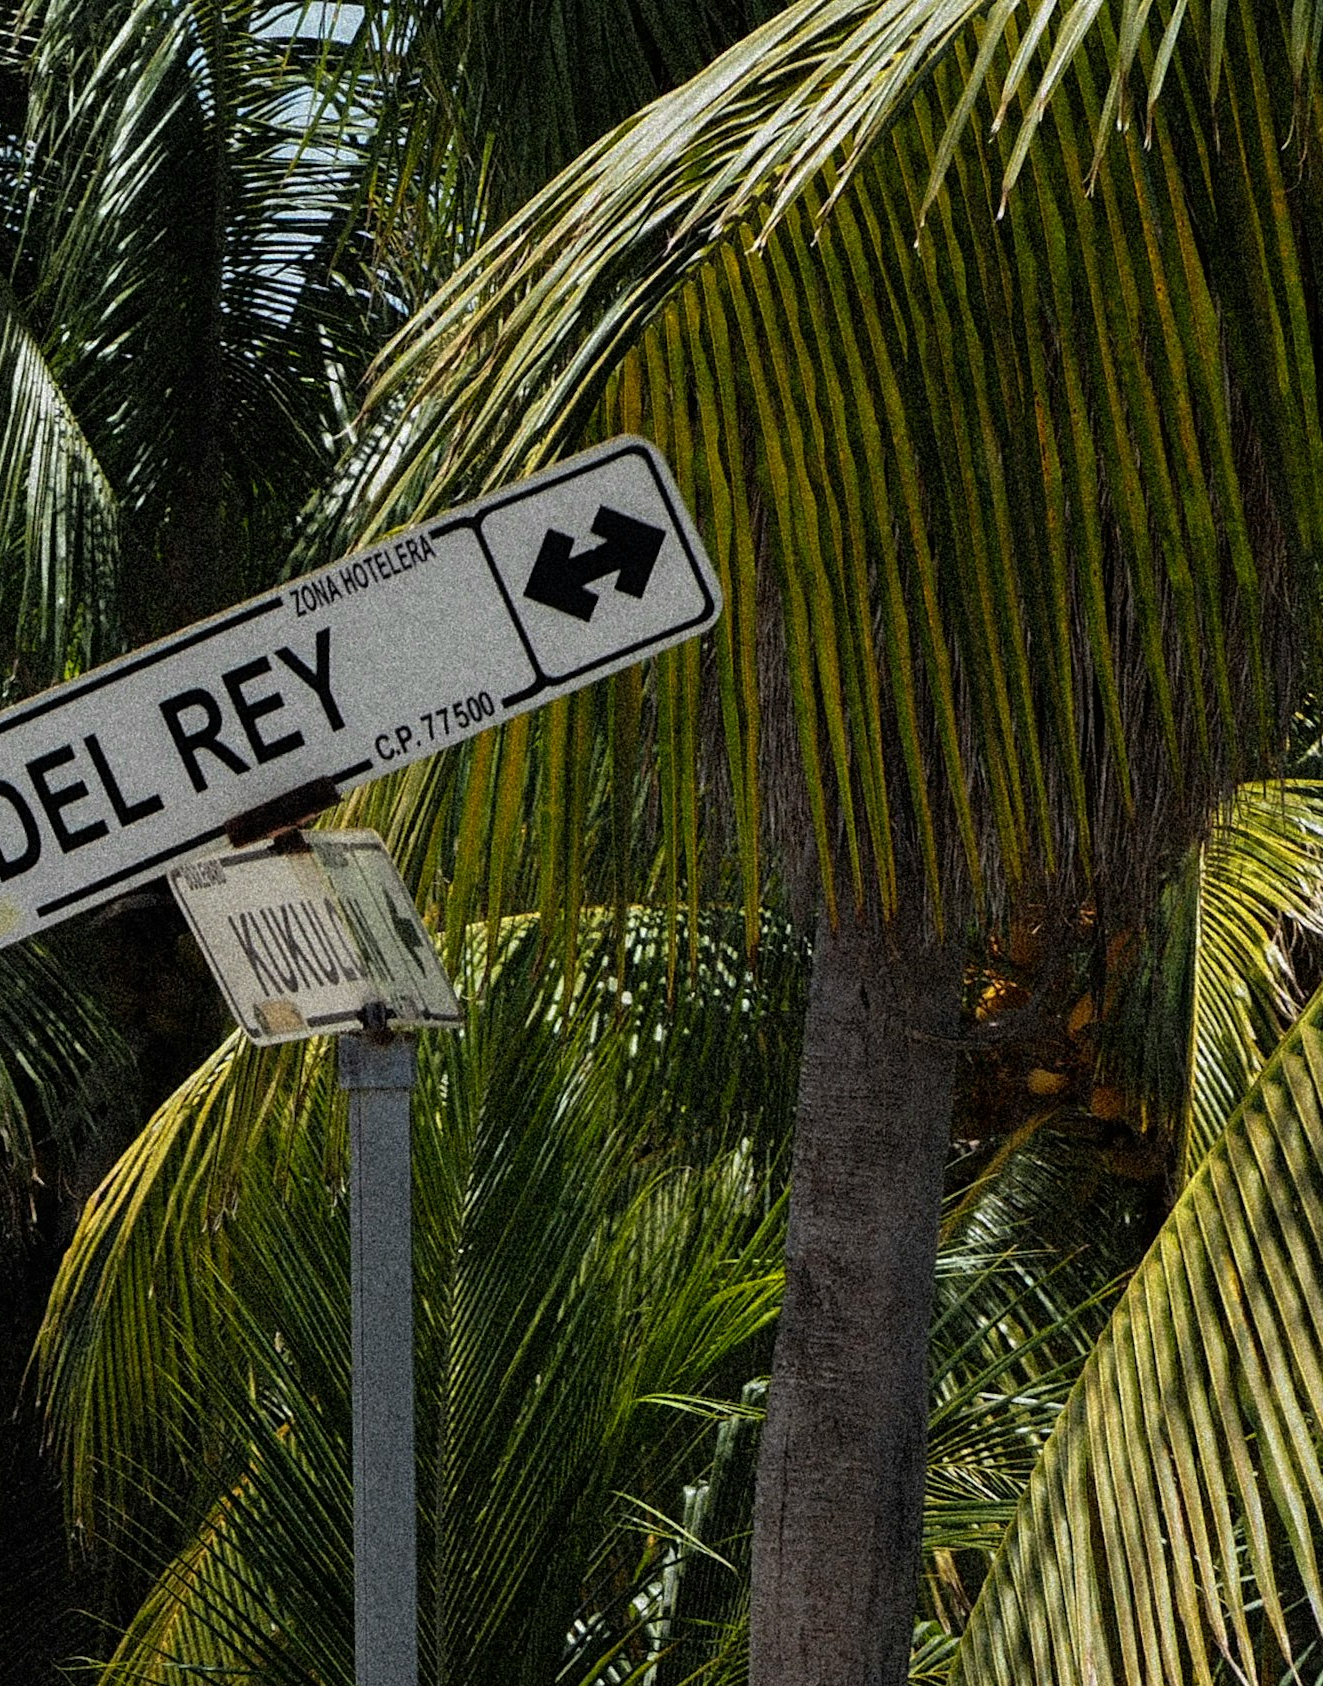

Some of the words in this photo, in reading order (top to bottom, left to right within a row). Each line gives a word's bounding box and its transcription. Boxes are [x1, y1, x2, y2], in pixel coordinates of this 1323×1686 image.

[289, 577, 341, 617] ZONA
[339, 536, 437, 595] HOTELERA
[158, 627, 346, 793] REY
[375, 725, 422, 762] C.P.
[419, 691, 496, 740] 77500
